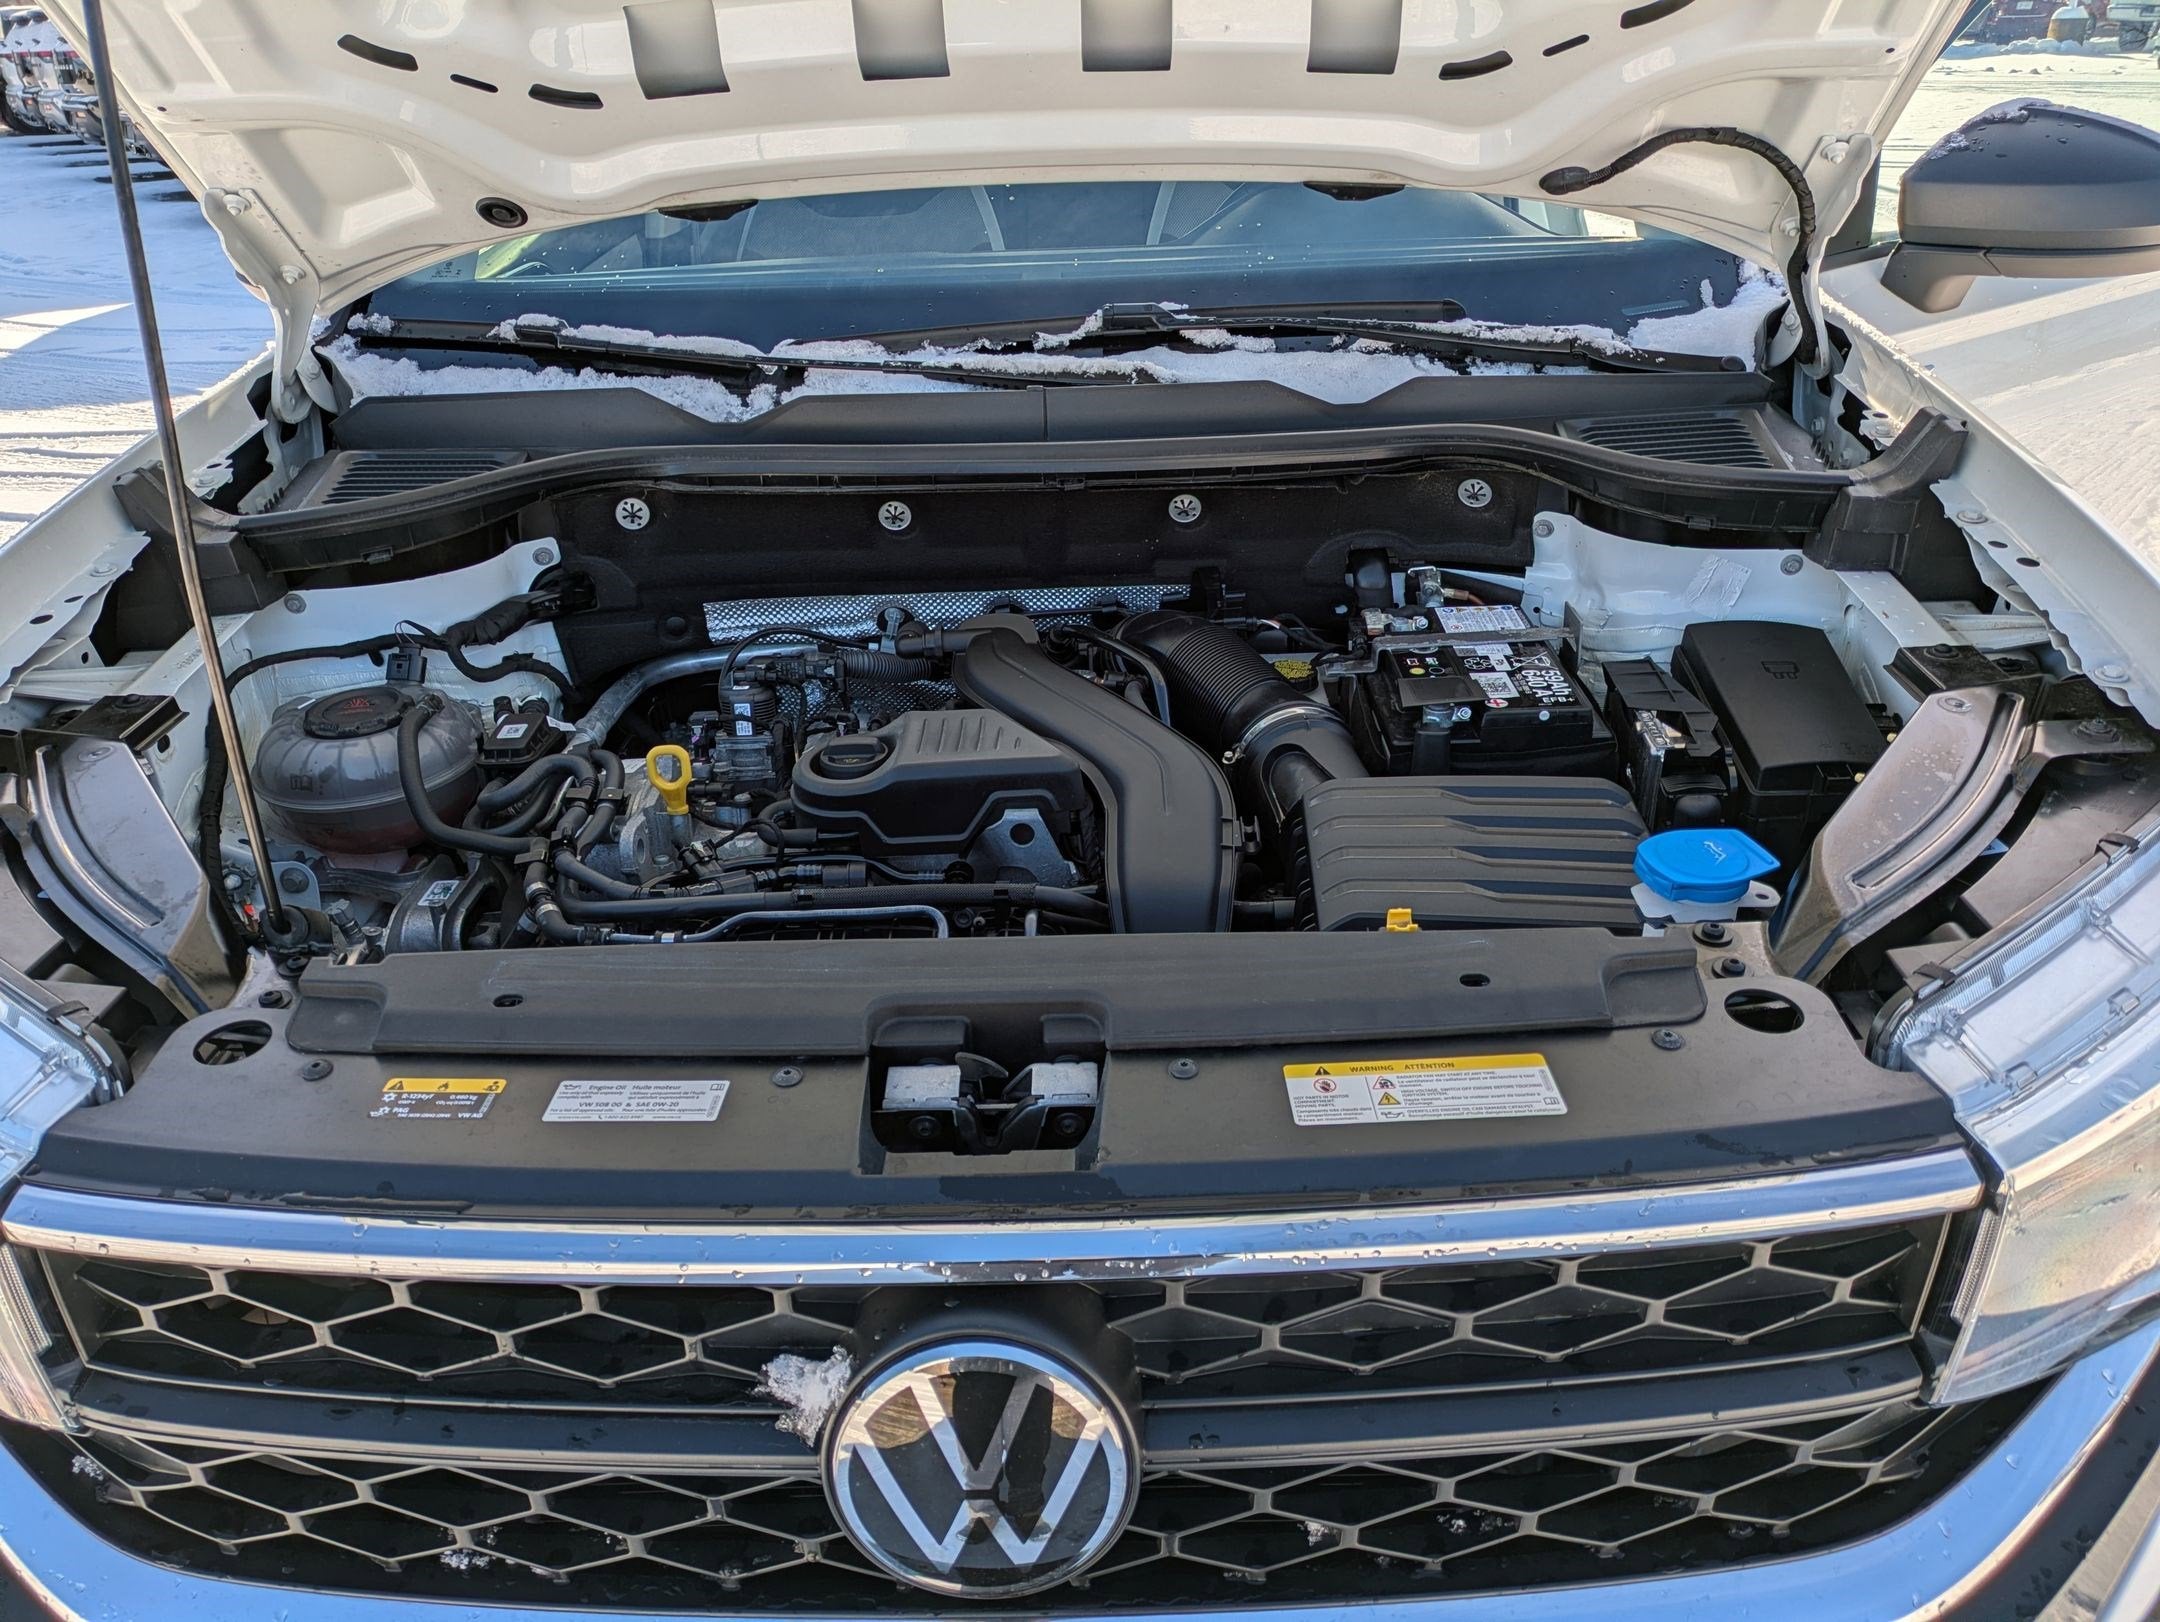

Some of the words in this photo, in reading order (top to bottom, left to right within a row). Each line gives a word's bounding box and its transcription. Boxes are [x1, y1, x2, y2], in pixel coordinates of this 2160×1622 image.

[1521, 669, 1548, 687] 640
[1541, 670, 1572, 695] 59Ah
[1349, 1064, 1394, 1073] WARNING
[1404, 1062, 1455, 1071] ATTENTION
[838, 1358, 1120, 1584] VW
